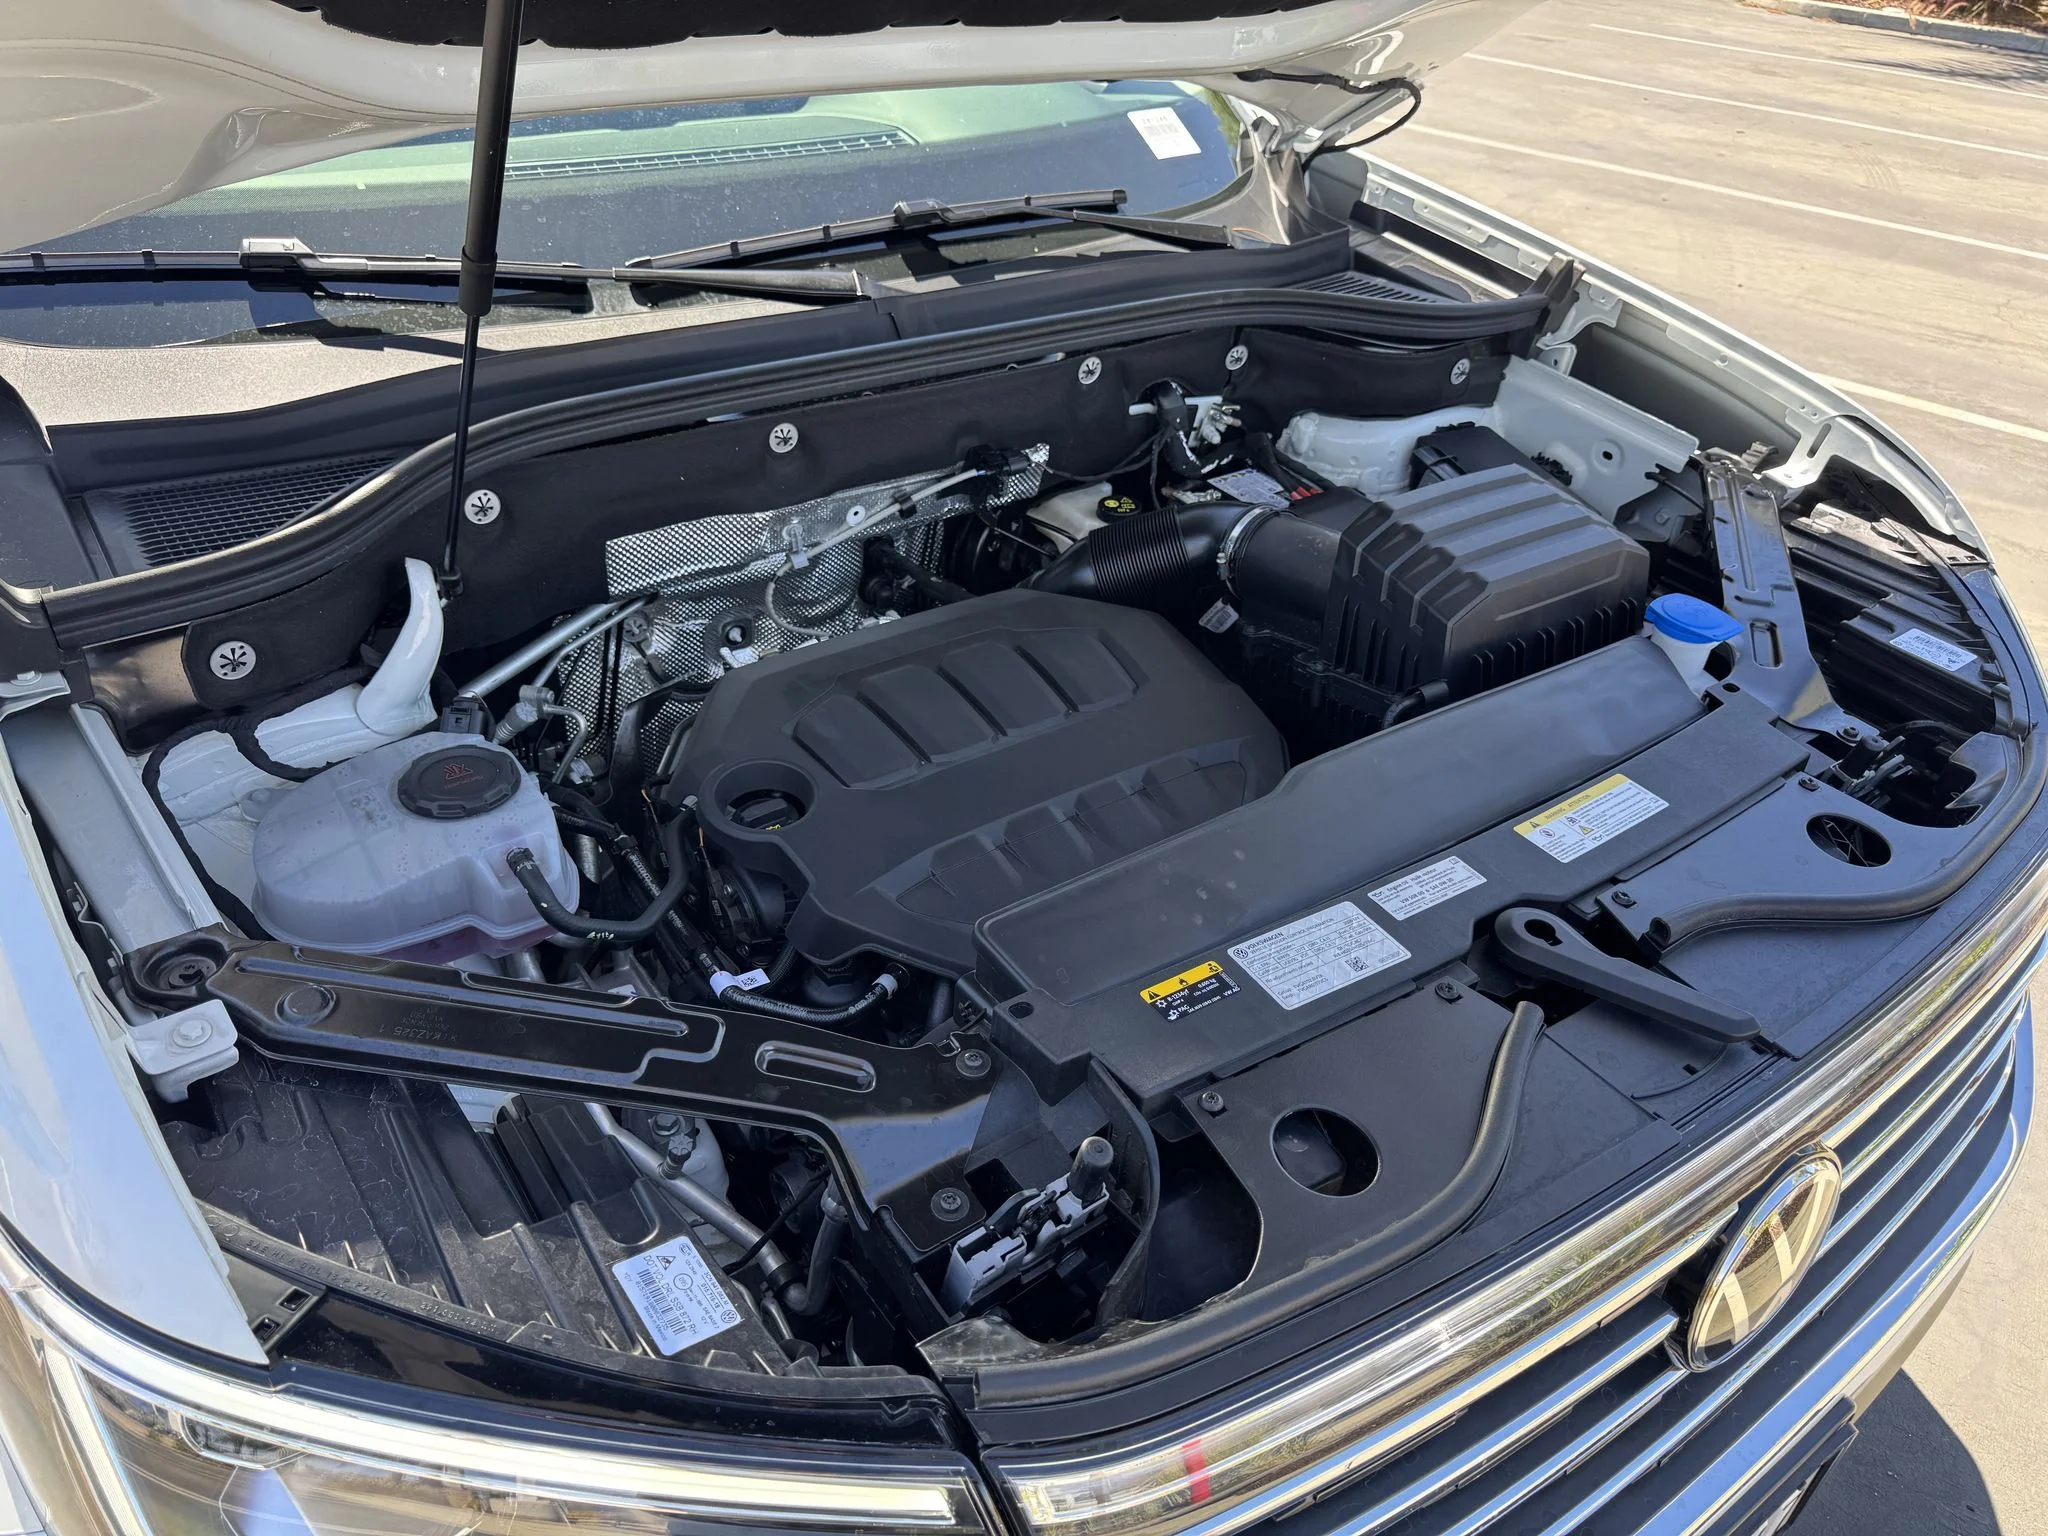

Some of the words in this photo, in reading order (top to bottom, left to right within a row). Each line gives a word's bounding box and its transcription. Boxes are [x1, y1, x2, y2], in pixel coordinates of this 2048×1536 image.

[1245, 932, 1284, 950] VOLKSWAGEN
[246, 1238, 269, 1253] SAE
[643, 1255, 658, 1270] DOT
[653, 1269, 666, 1283] VOL
[661, 1282, 675, 1298] DRL
[670, 1296, 684, 1312] SSB
[679, 1311, 691, 1324] 872
[687, 1323, 698, 1335] RH
